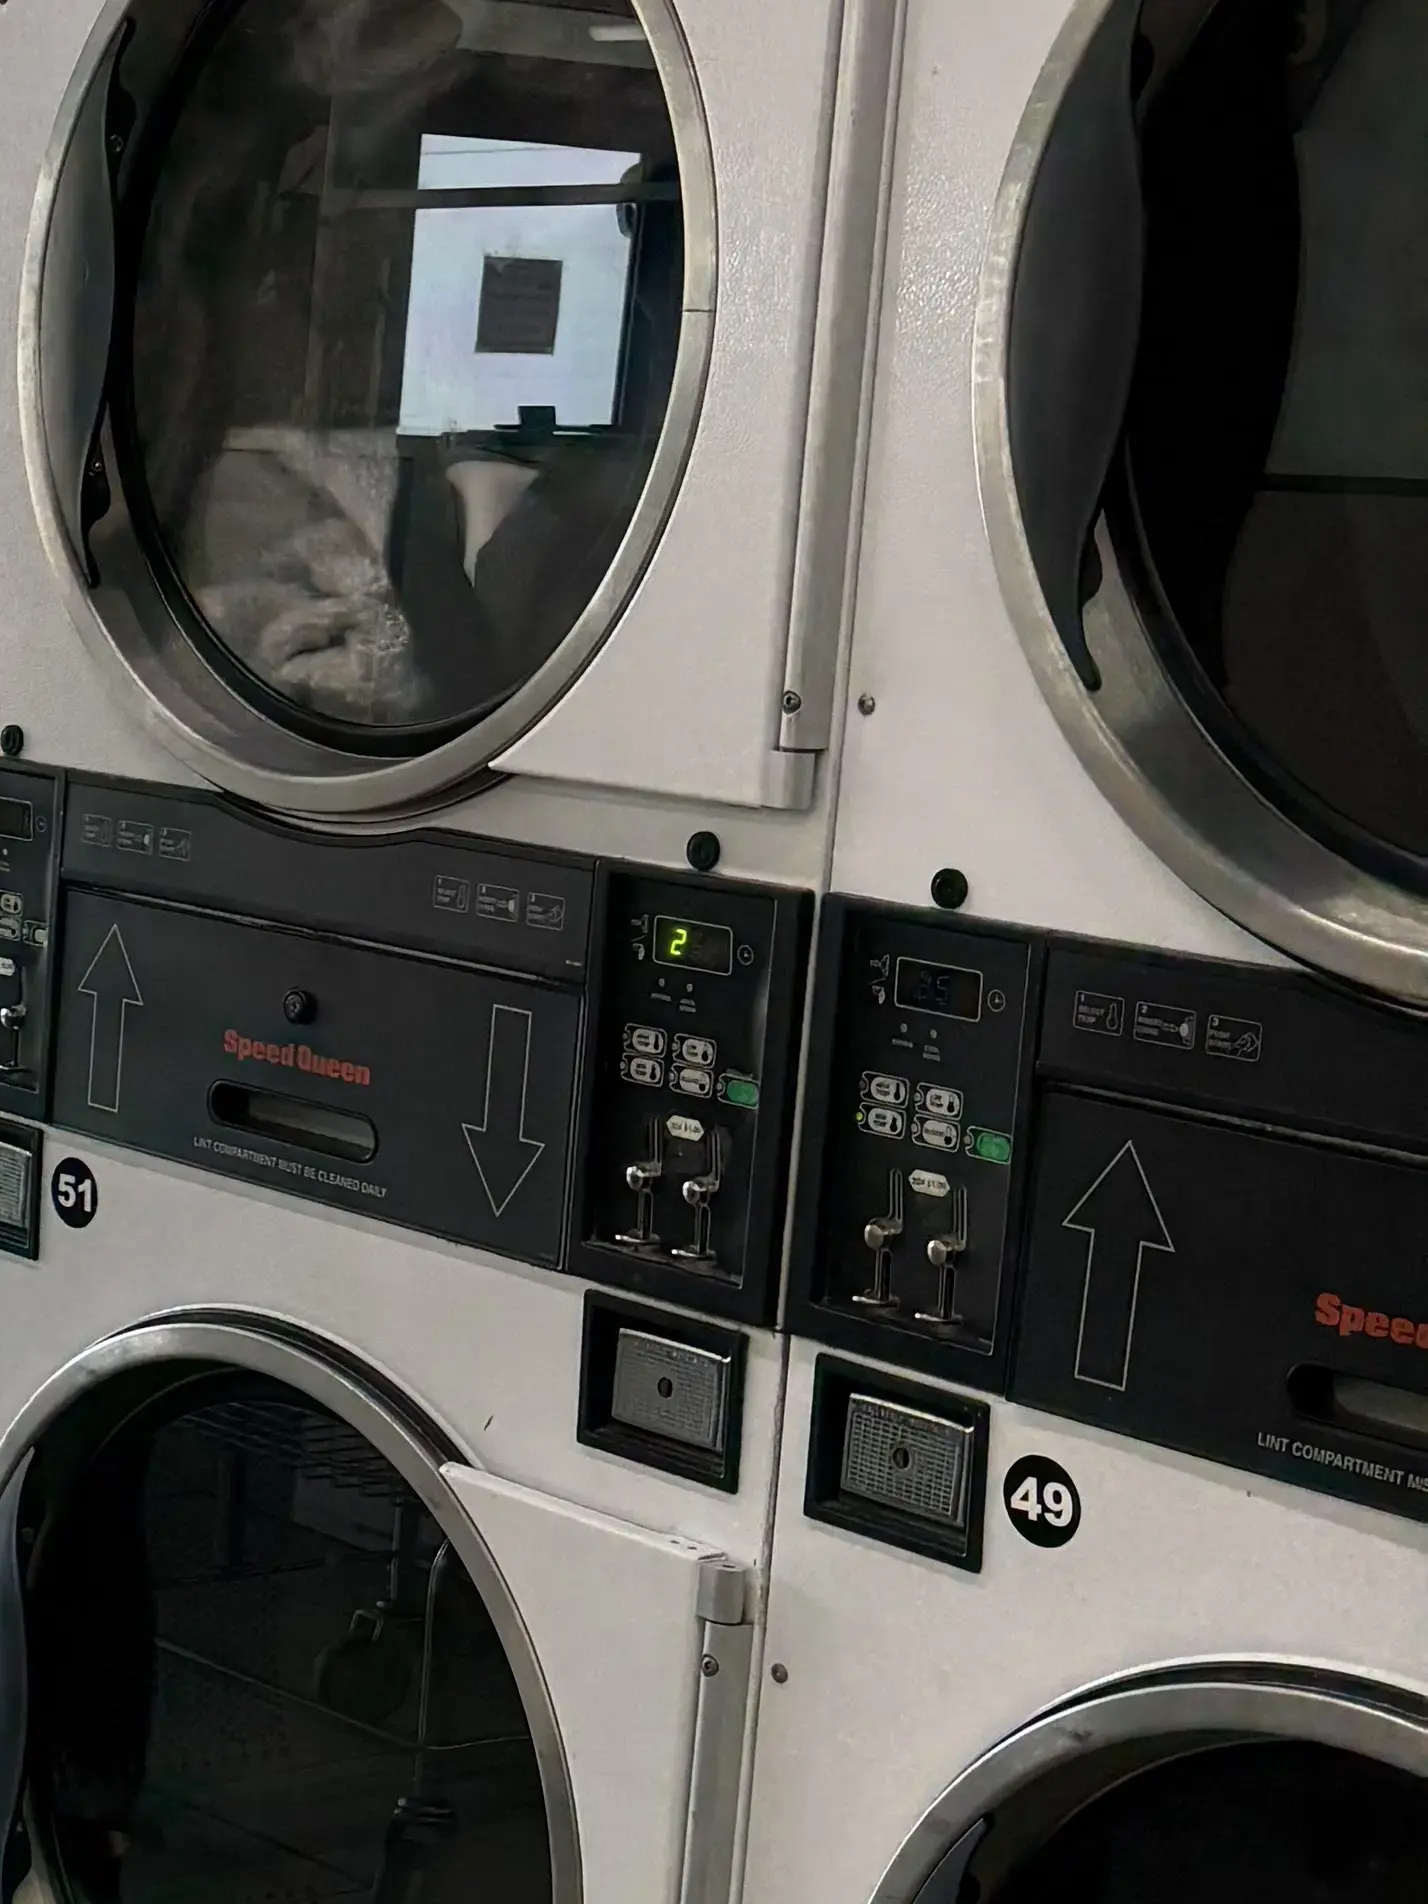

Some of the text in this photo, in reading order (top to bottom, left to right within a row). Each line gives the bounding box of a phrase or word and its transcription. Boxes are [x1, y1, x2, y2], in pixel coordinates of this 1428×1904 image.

[223, 1029, 371, 1086] Speed Queen
[57, 1172, 92, 1213] 51
[278, 1159, 303, 1175] MUST
[303, 1165, 317, 1180] BE
[317, 1169, 360, 1191] CLEANED
[1257, 1431, 1290, 1453] LINT
[1292, 1441, 1405, 1486] COMPARTMENT
[1010, 1476, 1073, 1528] 49
